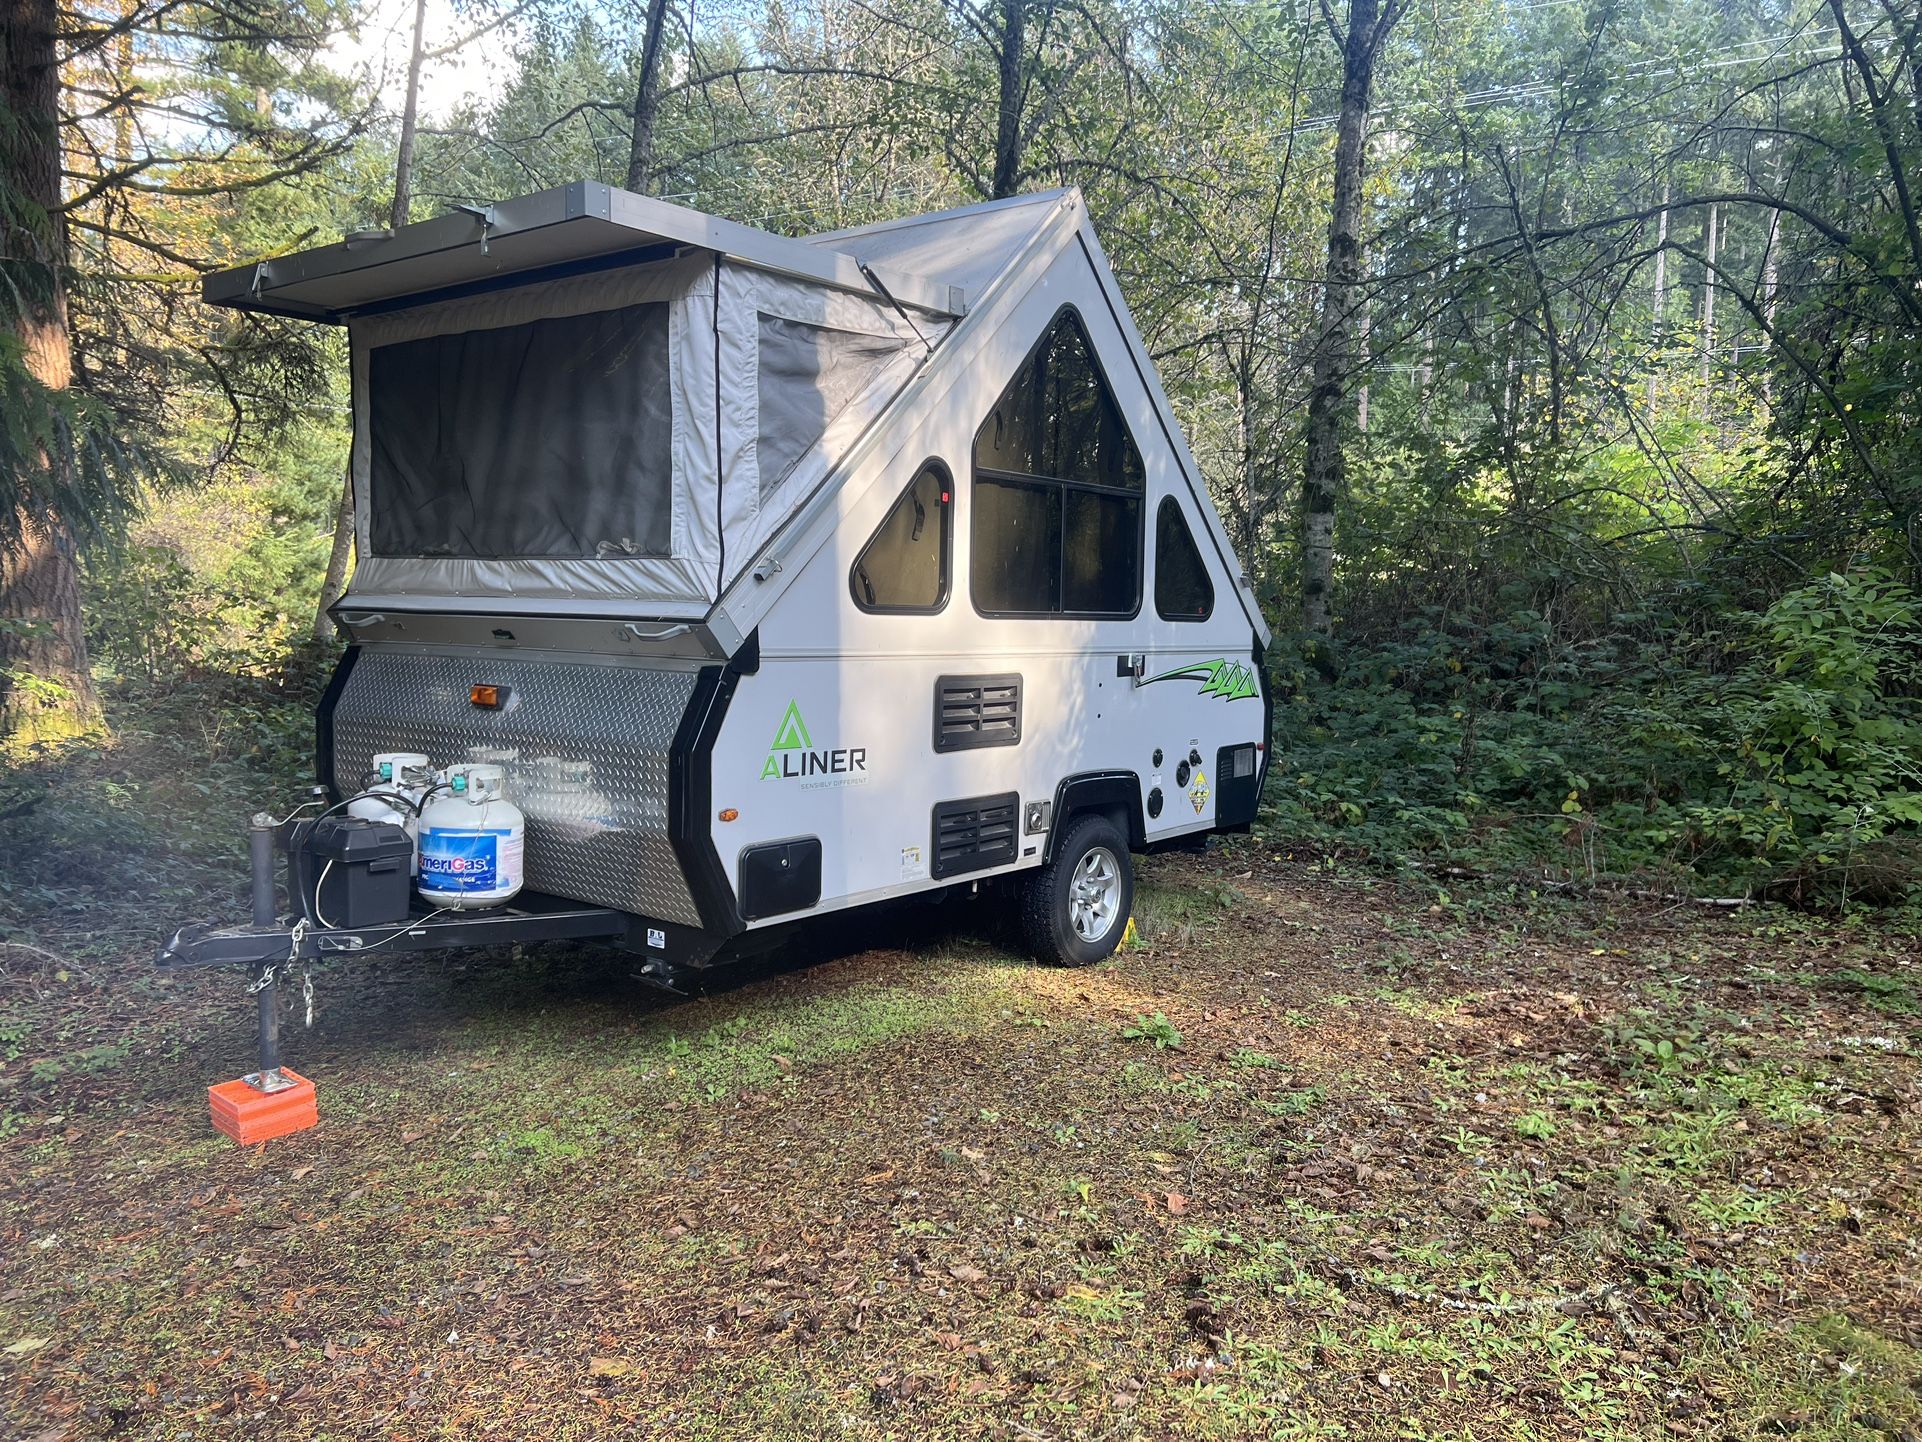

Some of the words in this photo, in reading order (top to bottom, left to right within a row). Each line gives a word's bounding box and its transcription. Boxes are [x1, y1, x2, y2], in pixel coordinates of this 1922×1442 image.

[760, 748, 866, 780] ALINER
[800, 781, 831, 790] SENSIBLY
[833, 778, 866, 787] DIFFERENT
